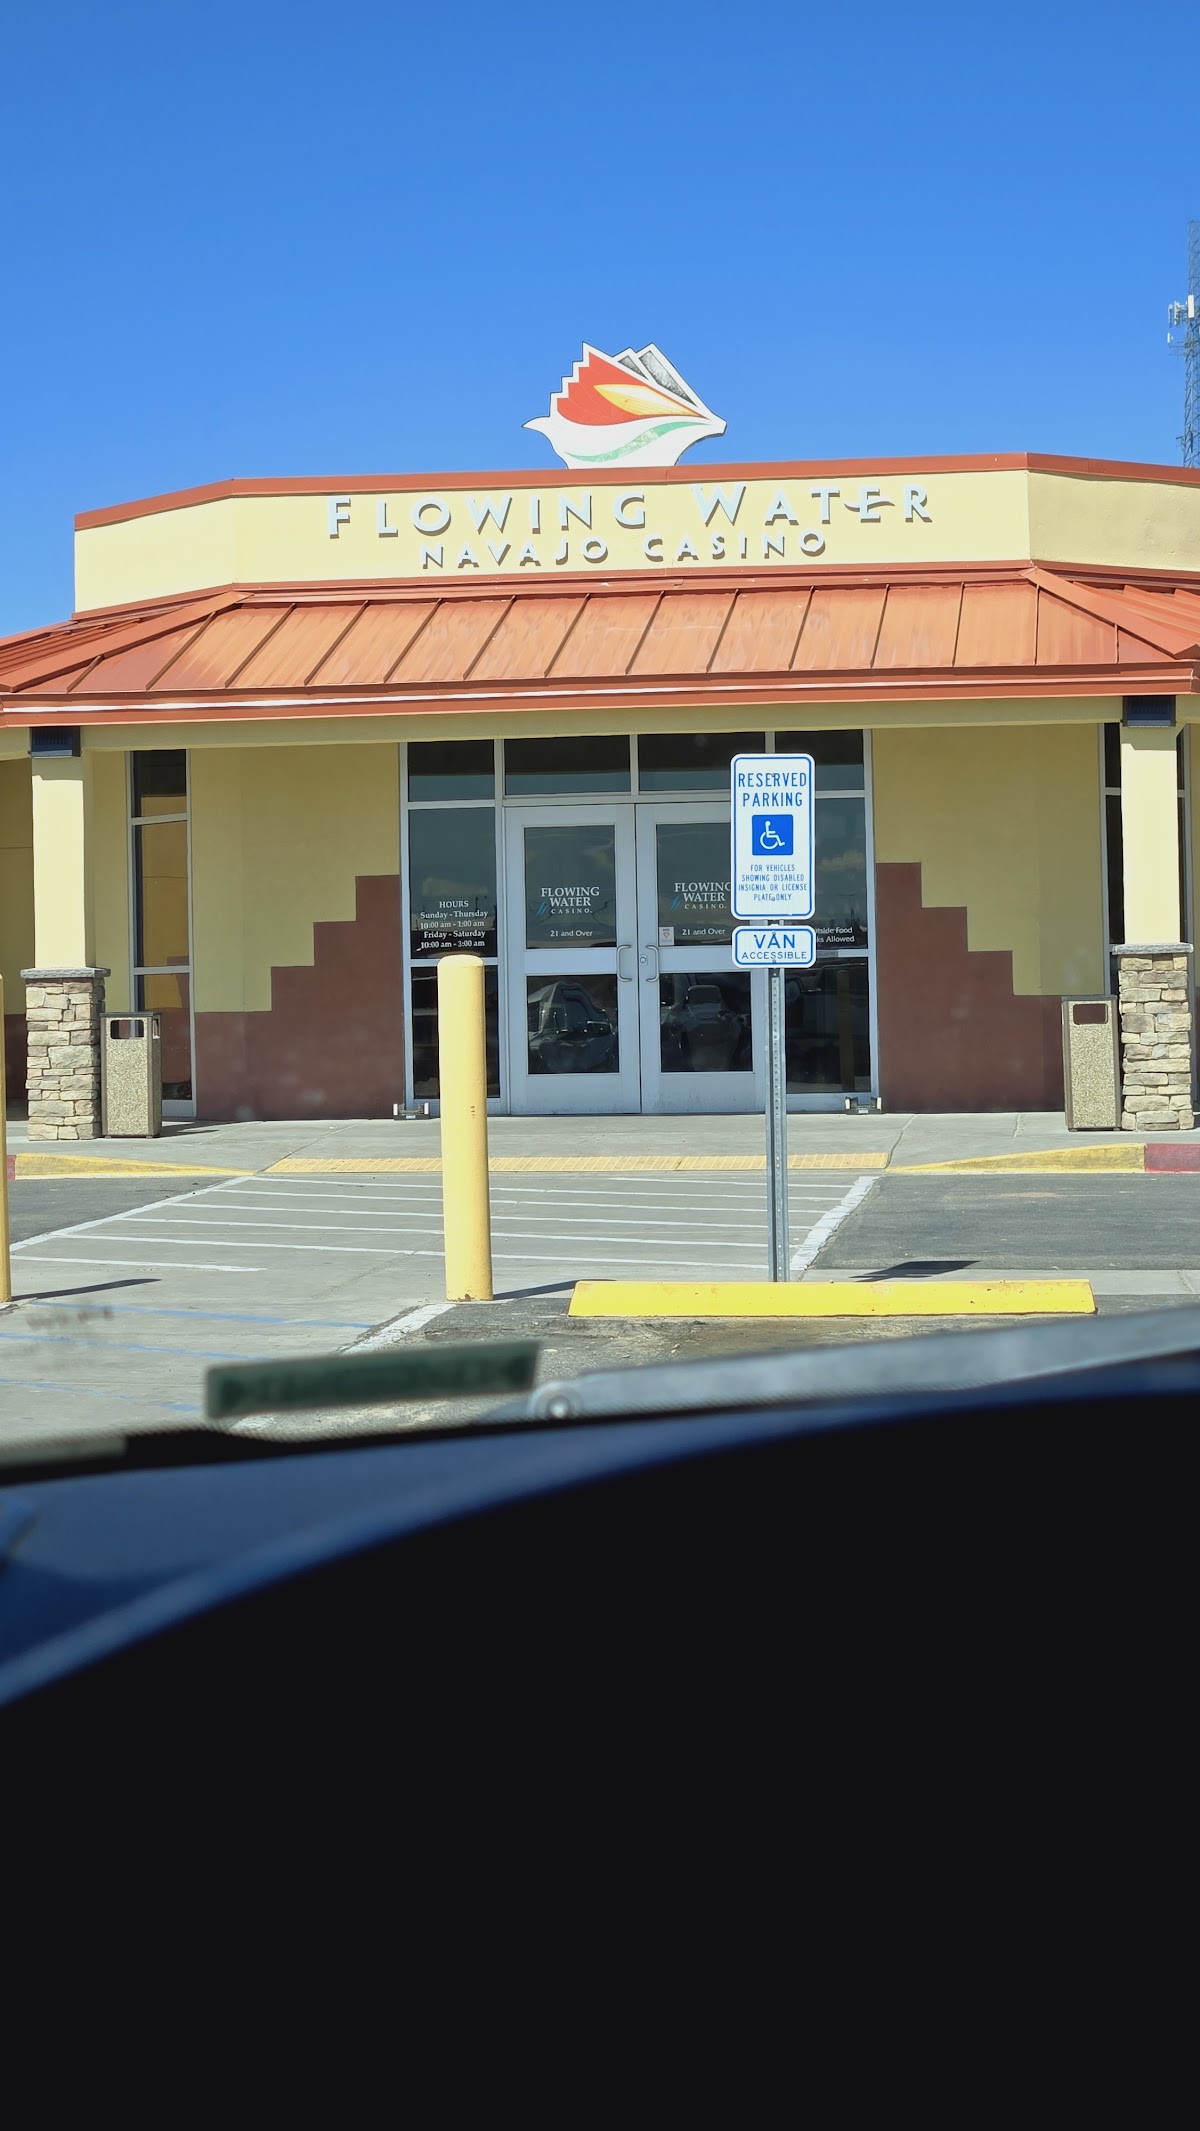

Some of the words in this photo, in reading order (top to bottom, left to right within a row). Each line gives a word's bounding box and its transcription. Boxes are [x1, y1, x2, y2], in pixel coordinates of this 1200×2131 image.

[327, 491, 646, 539] FLOWING
[691, 483, 933, 528] WATER
[419, 535, 609, 570] NAVAJO
[643, 528, 827, 562] CASINO
[738, 772, 807, 787] RESERVED
[742, 792, 803, 807] PARKING
[750, 864, 763, 872] FOR
[766, 864, 796, 872] VEHICLES
[741, 874, 770, 882] SHOWING
[773, 874, 805, 882] DISABLED
[541, 886, 600, 897] FLOWING
[738, 884, 767, 892] INSIGNIA
[781, 883, 808, 891] LICENSE
[549, 896, 592, 907] WATER
[683, 892, 726, 902] WATER
[753, 893, 772, 901] PLATE
[775, 893, 793, 901] ONLY
[439, 900, 470, 909] HOURS
[420, 911, 448, 920] Sunday
[453, 910, 489, 918] Thursday
[420, 921, 439, 930] 10:00
[457, 920, 472, 928] 1:00
[423, 930, 448, 940] Friday
[453, 929, 486, 939] Saturday
[550, 929, 559, 937] 21
[575, 929, 593, 937] Over
[681, 928, 691, 936] 21
[692, 928, 707, 936] and
[707, 927, 726, 935] Over
[753, 933, 795, 949] VAN
[825, 935, 855, 943] Allowed
[420, 941, 440, 949] 10:00
[741, 951, 807, 960] ACCESSIBLE
